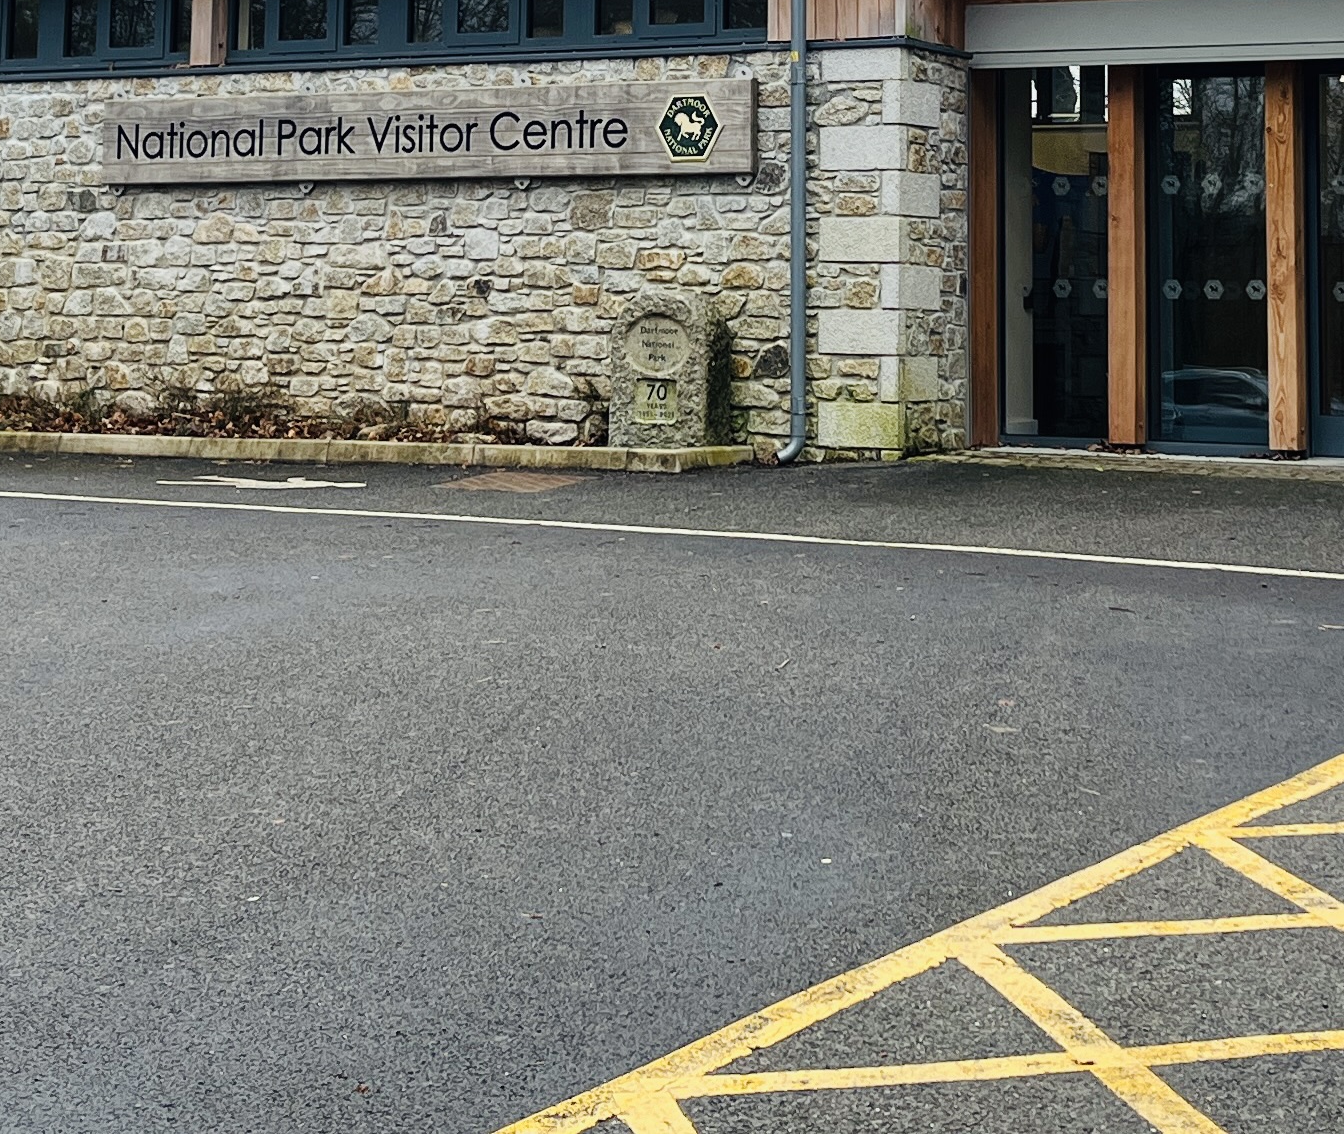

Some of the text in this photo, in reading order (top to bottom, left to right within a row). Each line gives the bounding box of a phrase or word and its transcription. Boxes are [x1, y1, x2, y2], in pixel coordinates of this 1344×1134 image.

[667, 98, 710, 118] DARTMOOR
[116, 109, 629, 160] National Park Visitor Centre
[664, 127, 713, 154] NATIONAL PARK
[640, 326, 678, 334] Dartmoor
[642, 340, 674, 348] National
[647, 383, 667, 400] 70
